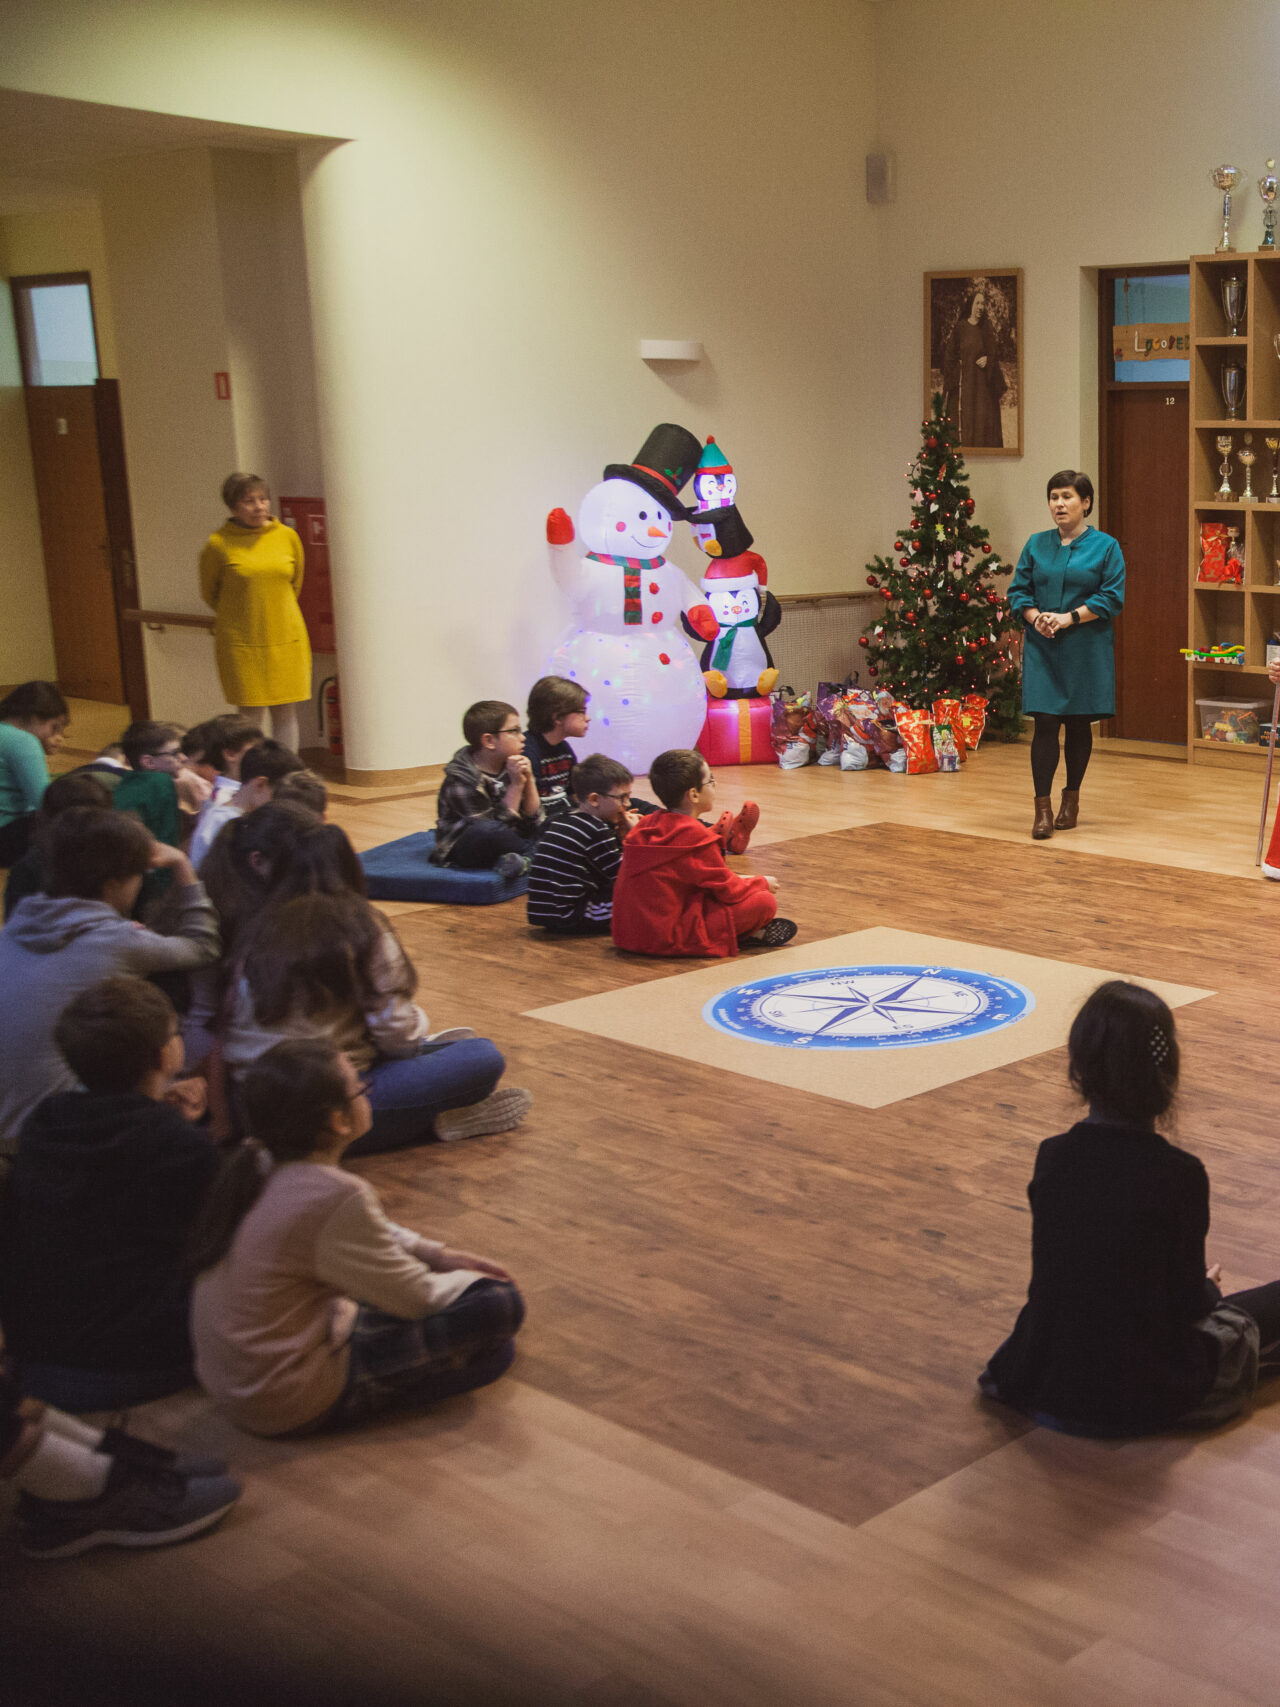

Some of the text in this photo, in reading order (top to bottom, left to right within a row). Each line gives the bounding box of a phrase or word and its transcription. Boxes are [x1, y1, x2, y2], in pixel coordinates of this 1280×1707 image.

[1165, 397, 1175, 405] 12
[737, 988, 763, 996] W
[991, 1013, 1011, 1021] E
[791, 1035, 815, 1045] S
